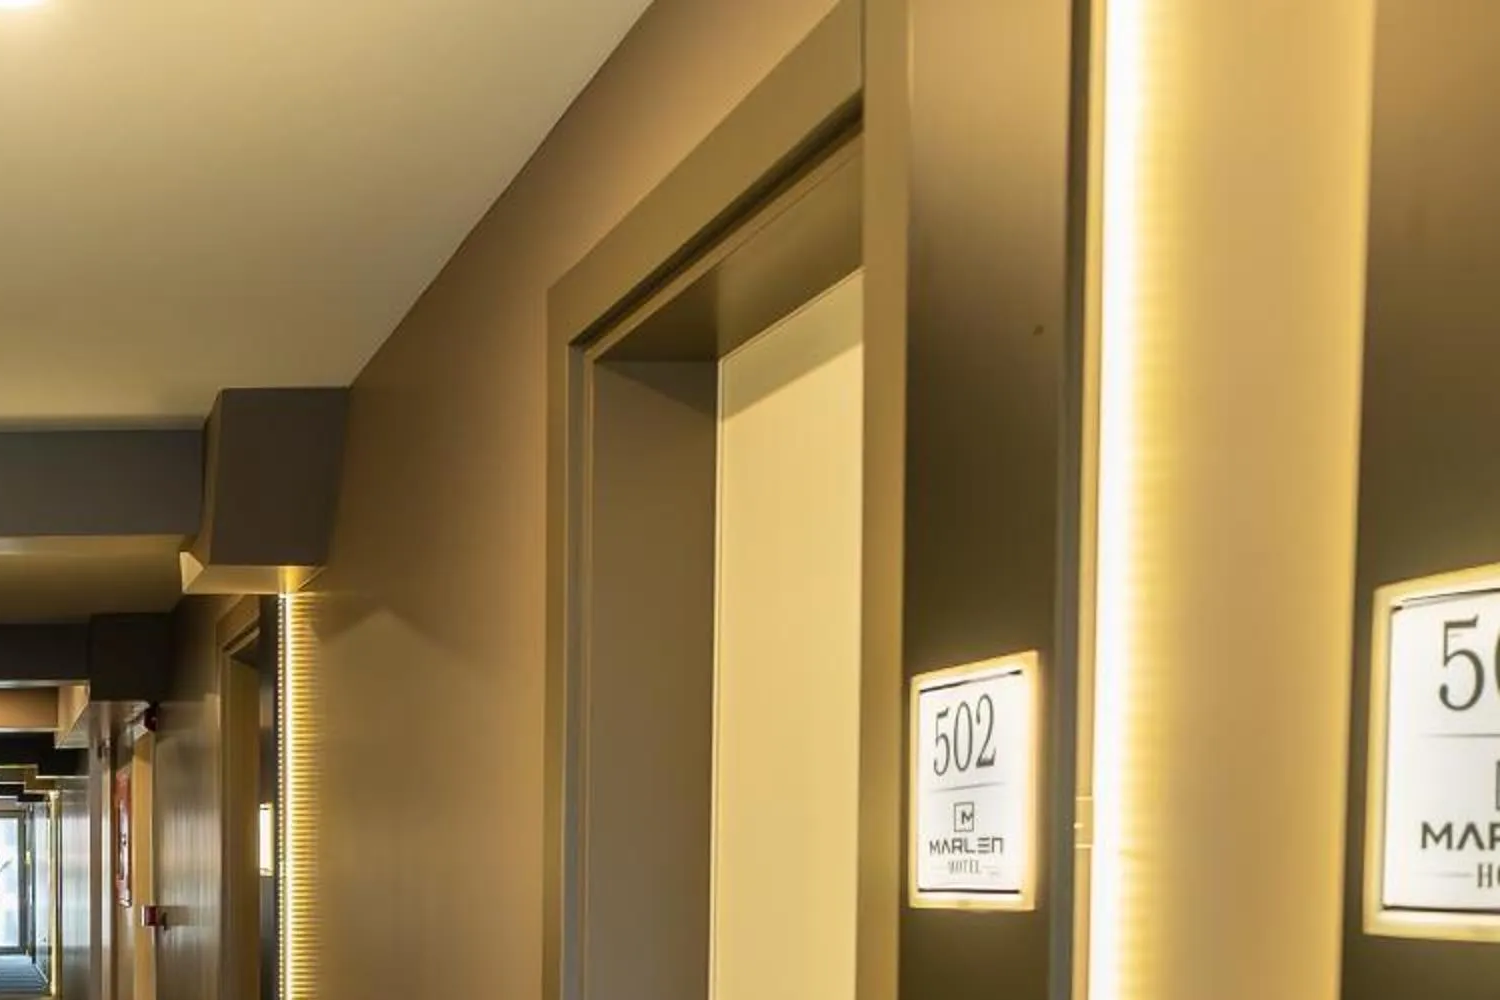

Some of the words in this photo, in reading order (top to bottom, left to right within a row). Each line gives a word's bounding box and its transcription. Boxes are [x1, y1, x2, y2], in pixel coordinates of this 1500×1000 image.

[1438, 614, 1500, 712] 5
[933, 693, 997, 776] 502
[929, 836, 1004, 855] MARLEN
